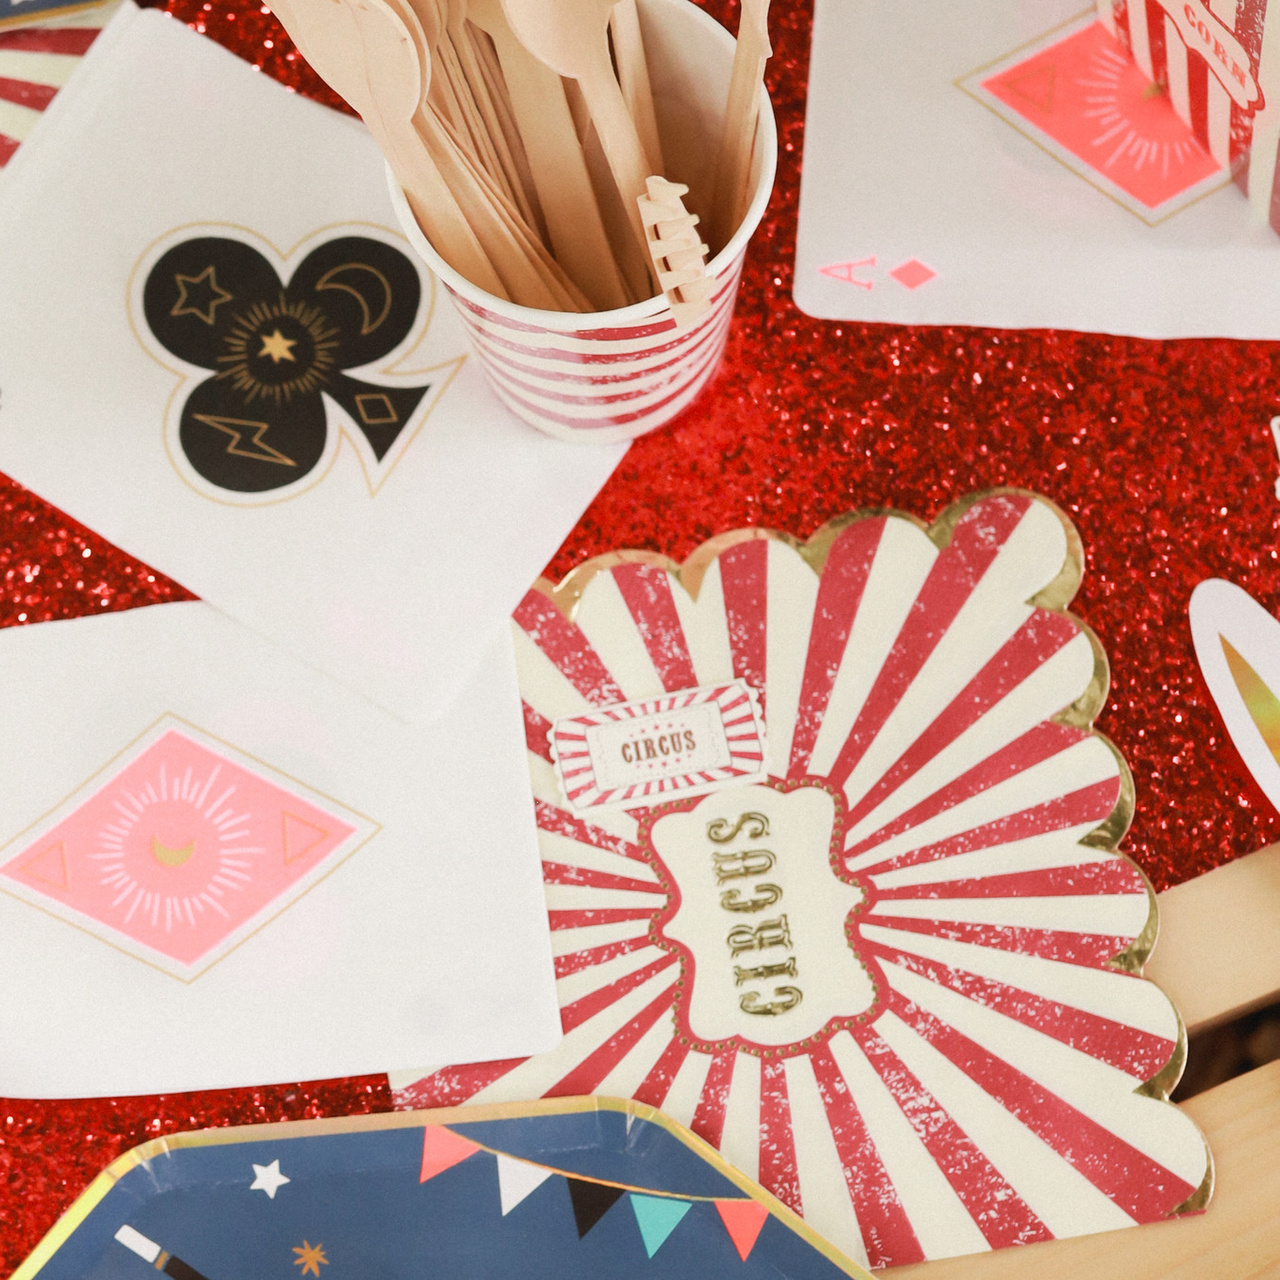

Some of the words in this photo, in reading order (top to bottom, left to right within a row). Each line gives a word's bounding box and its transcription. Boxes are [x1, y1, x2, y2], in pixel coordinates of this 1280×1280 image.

[1183, 3, 1247, 90] CORN
[818, 255, 876, 291] A
[621, 729, 697, 764] CIRCUS
[706, 811, 804, 1017] CIRCUS
